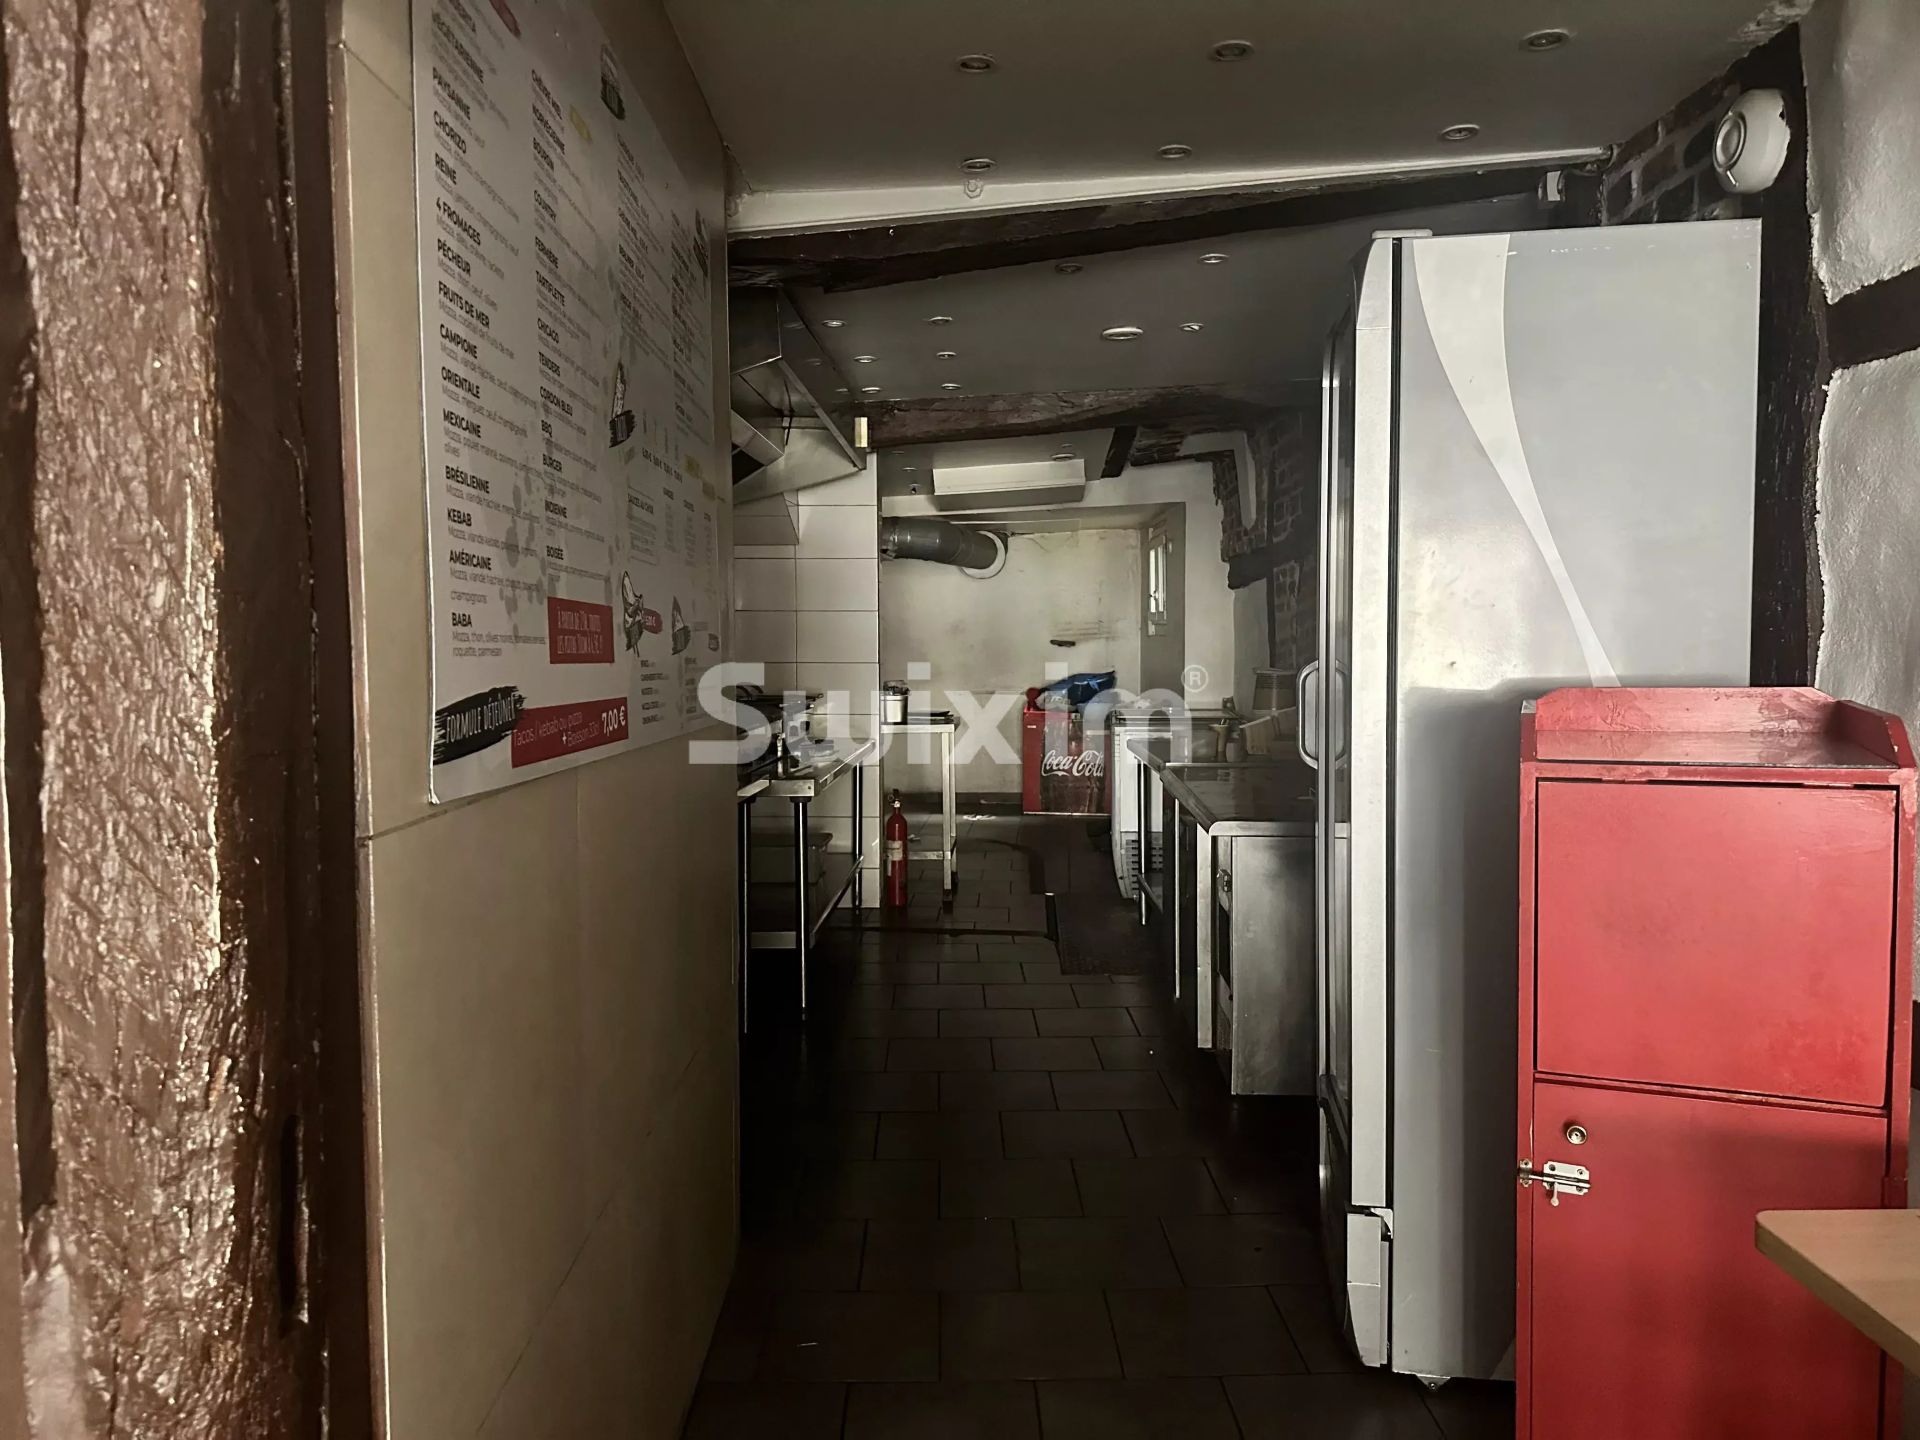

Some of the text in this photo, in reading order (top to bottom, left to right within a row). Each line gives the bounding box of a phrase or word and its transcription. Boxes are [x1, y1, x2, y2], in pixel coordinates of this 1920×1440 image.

[432, 67, 470, 120] PAYSANNE
[433, 111, 466, 154] CHORIZO
[435, 153, 456, 185] REINE
[534, 190, 556, 222] COUNTRY
[436, 197, 481, 246] 4 FROMAGES
[535, 236, 558, 269] FERMIÈRE
[535, 270, 565, 306] TARTIFLETTE
[438, 281, 489, 329] FRUITS DE MER
[440, 324, 477, 359] CAMPIONE
[537, 317, 559, 344] CHICAGO
[538, 351, 560, 377] TENDERS
[441, 366, 480, 399] ORIENTALE
[539, 386, 572, 416] CORDON BLEU
[443, 409, 481, 438] MEXICAINE
[541, 419, 552, 438] BBQ
[542, 453, 562, 472] BURGER
[445, 465, 489, 494] BRÉSILIENNE
[447, 508, 472, 527] KEBAB
[544, 499, 567, 518] INDIENNE
[449, 549, 491, 570] AMÉRICAINE
[546, 545, 564, 560] BOISÉE
[451, 612, 472, 627] BABA
[446, 707, 482, 744] FORMULE
[513, 729, 535, 746] Tacos
[539, 719, 558, 738] kebab
[559, 717, 567, 730] ou
[602, 705, 626, 737] 7,00 €
[562, 731, 567, 744] +
[567, 726, 588, 747] Boisson
